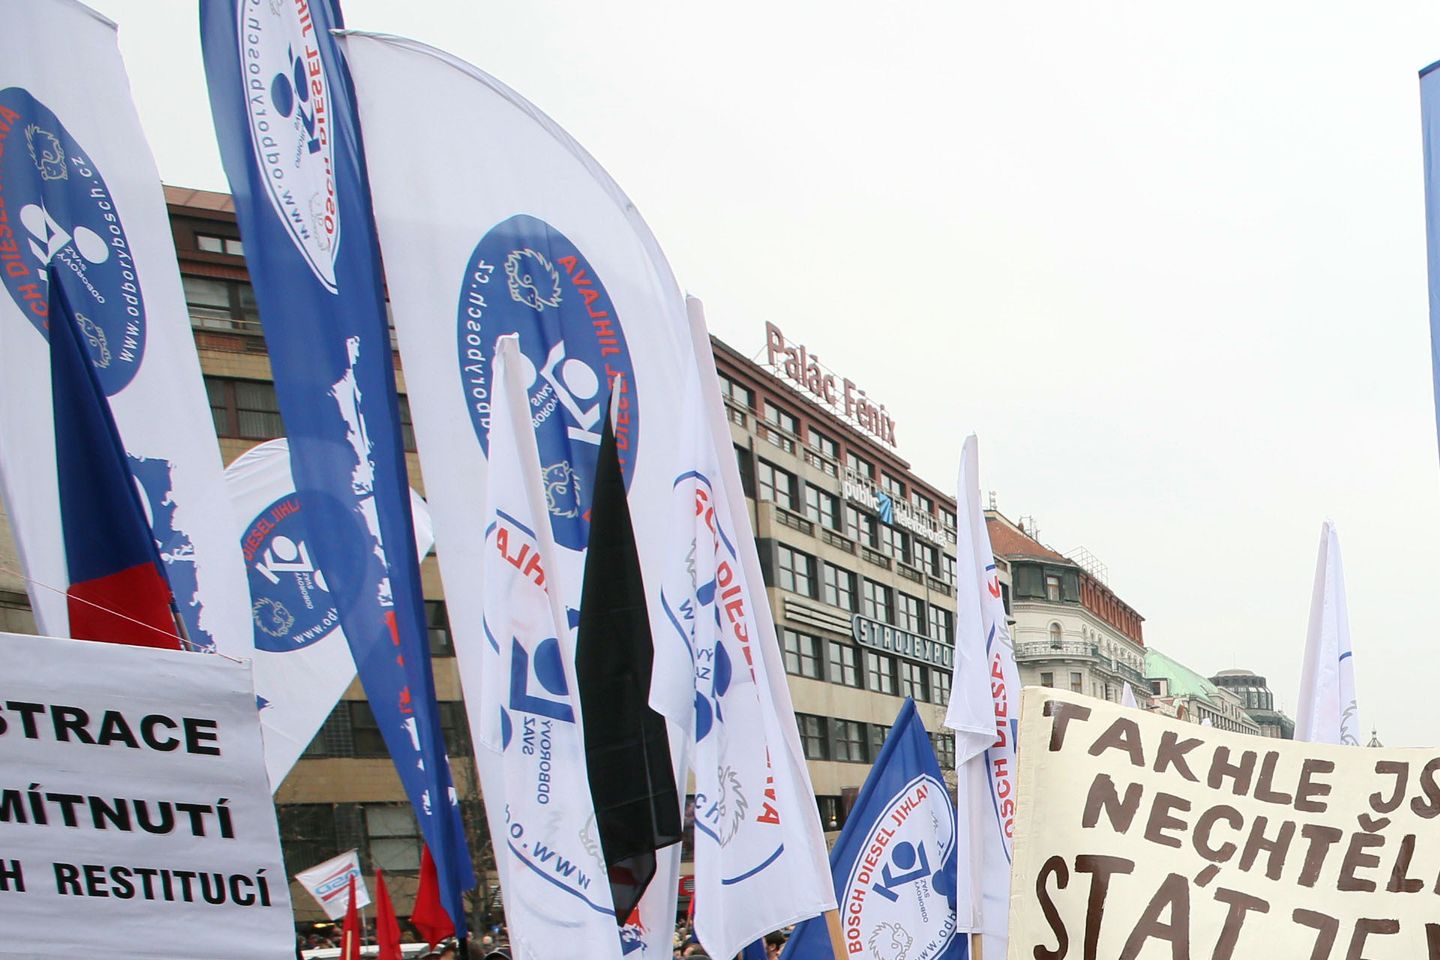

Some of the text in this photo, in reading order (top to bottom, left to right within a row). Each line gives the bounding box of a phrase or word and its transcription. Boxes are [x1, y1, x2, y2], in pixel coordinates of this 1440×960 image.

[70, 154, 136, 363] www.odborybosch.cz
[765, 320, 837, 406] Palác
[860, 619, 952, 666] STROJEXPO
[1043, 699, 1335, 813] TAKHLE
[52, 858, 271, 908] RESTITUCÍ
[857, 824, 896, 886] DIESEL
[849, 888, 867, 954] BOSCH
